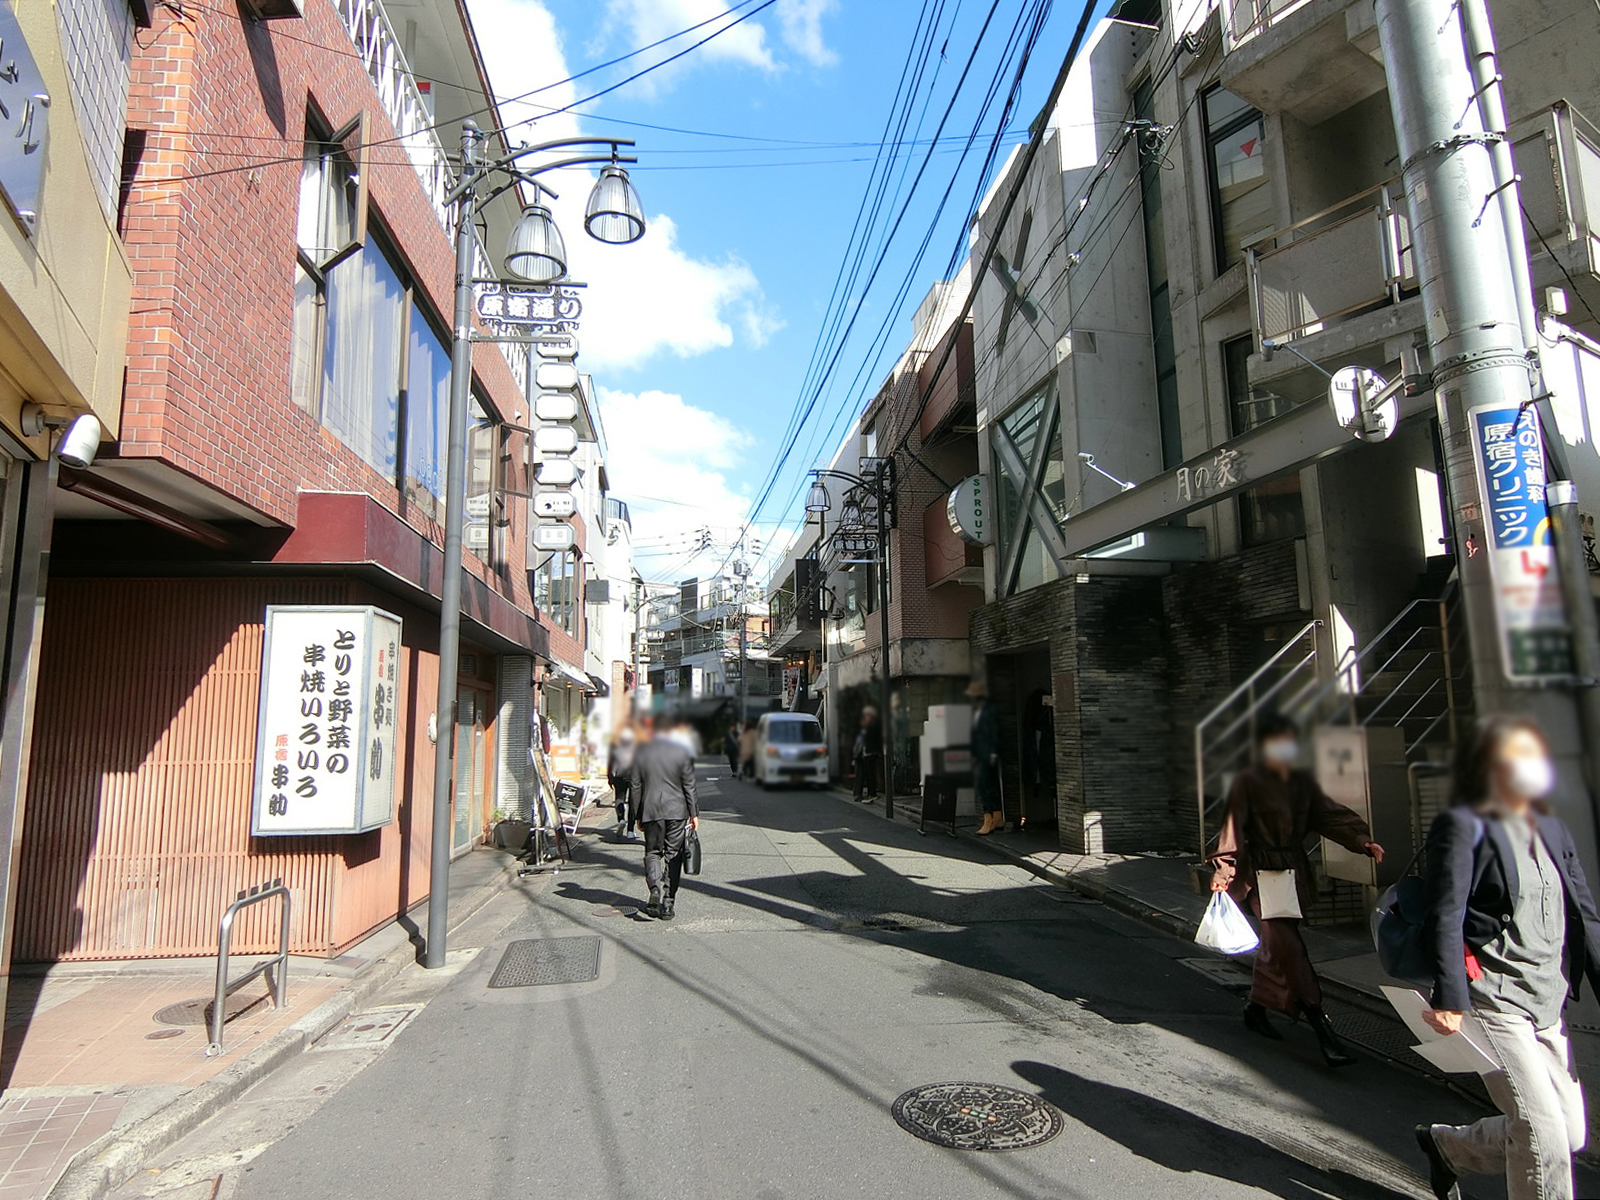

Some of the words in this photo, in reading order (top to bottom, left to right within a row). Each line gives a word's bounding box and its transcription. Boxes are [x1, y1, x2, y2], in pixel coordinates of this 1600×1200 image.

[480, 295, 580, 319] 原宿通り
[1176, 448, 1238, 503] 月の家
[1484, 422, 1529, 546] 原宿クリニック
[1517, 411, 1545, 504] えのき歯科
[835, 539, 876, 550] 原宿通り
[973, 478, 983, 539] SPROUT
[295, 643, 326, 798] 串焼いろいろ
[326, 629, 356, 774] とりと野菜の
